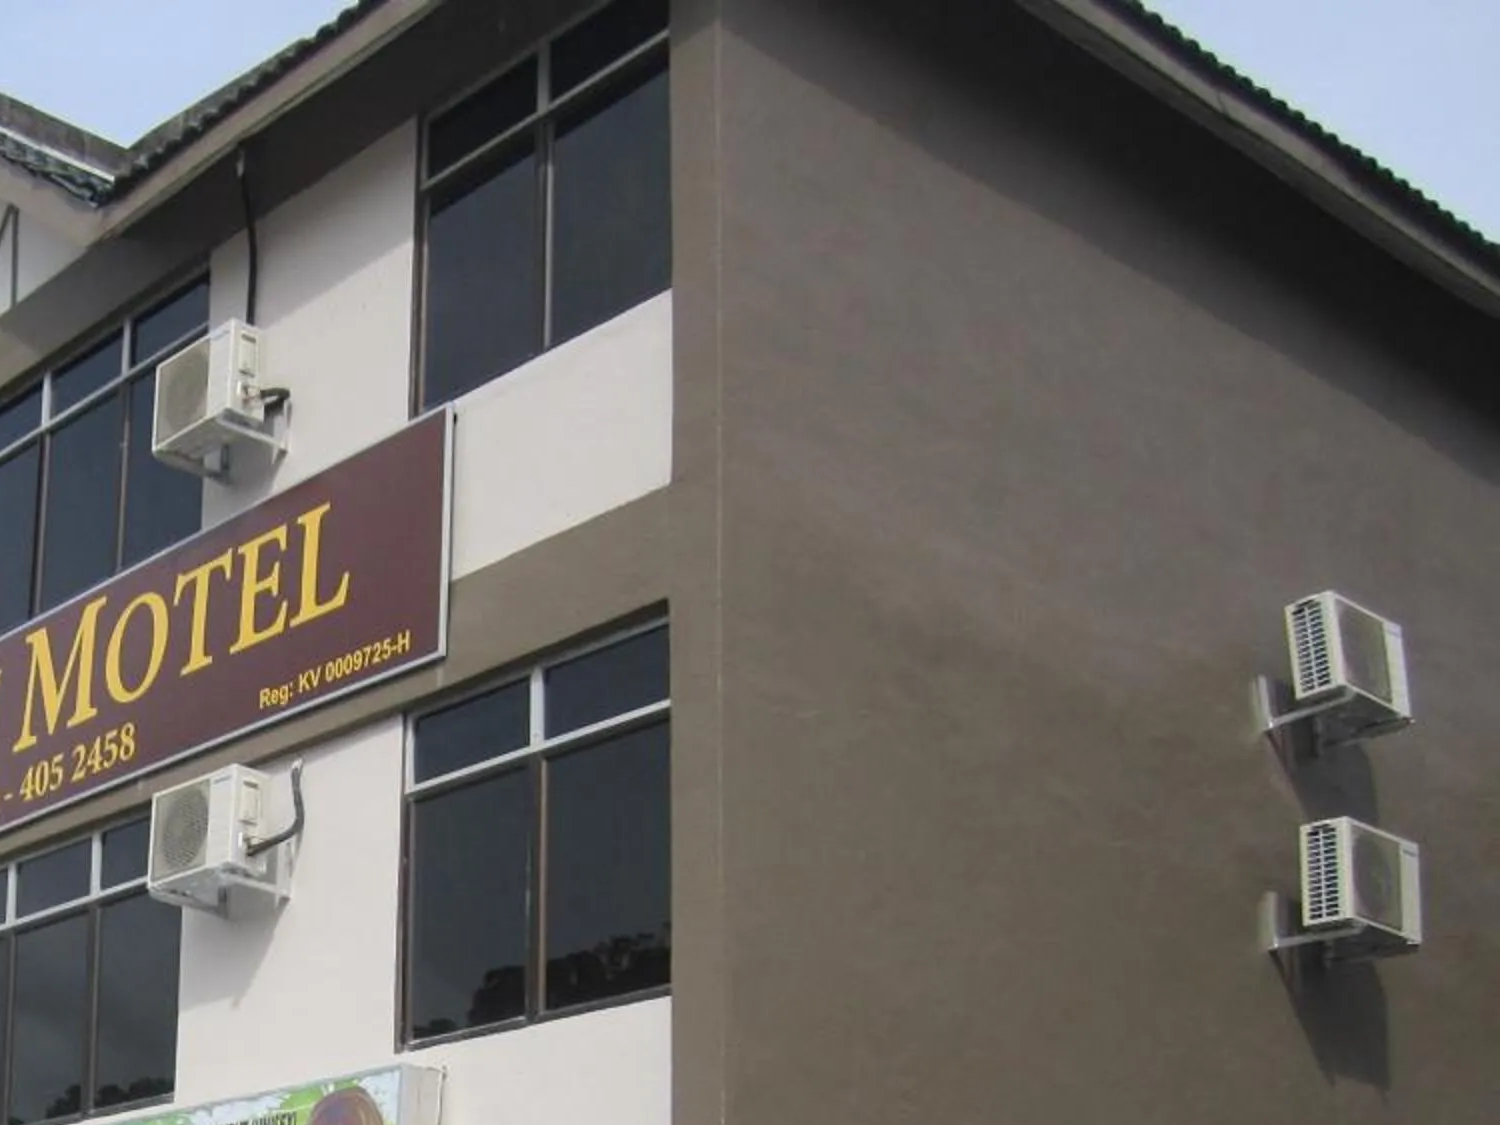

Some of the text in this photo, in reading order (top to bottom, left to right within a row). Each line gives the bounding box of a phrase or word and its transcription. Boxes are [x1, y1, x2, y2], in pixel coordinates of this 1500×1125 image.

[12, 502, 350, 753] MOTEL
[259, 630, 412, 709] Reg: KV 0009725-H
[20, 753, 65, 800] 405
[72, 721, 137, 782] 2458
